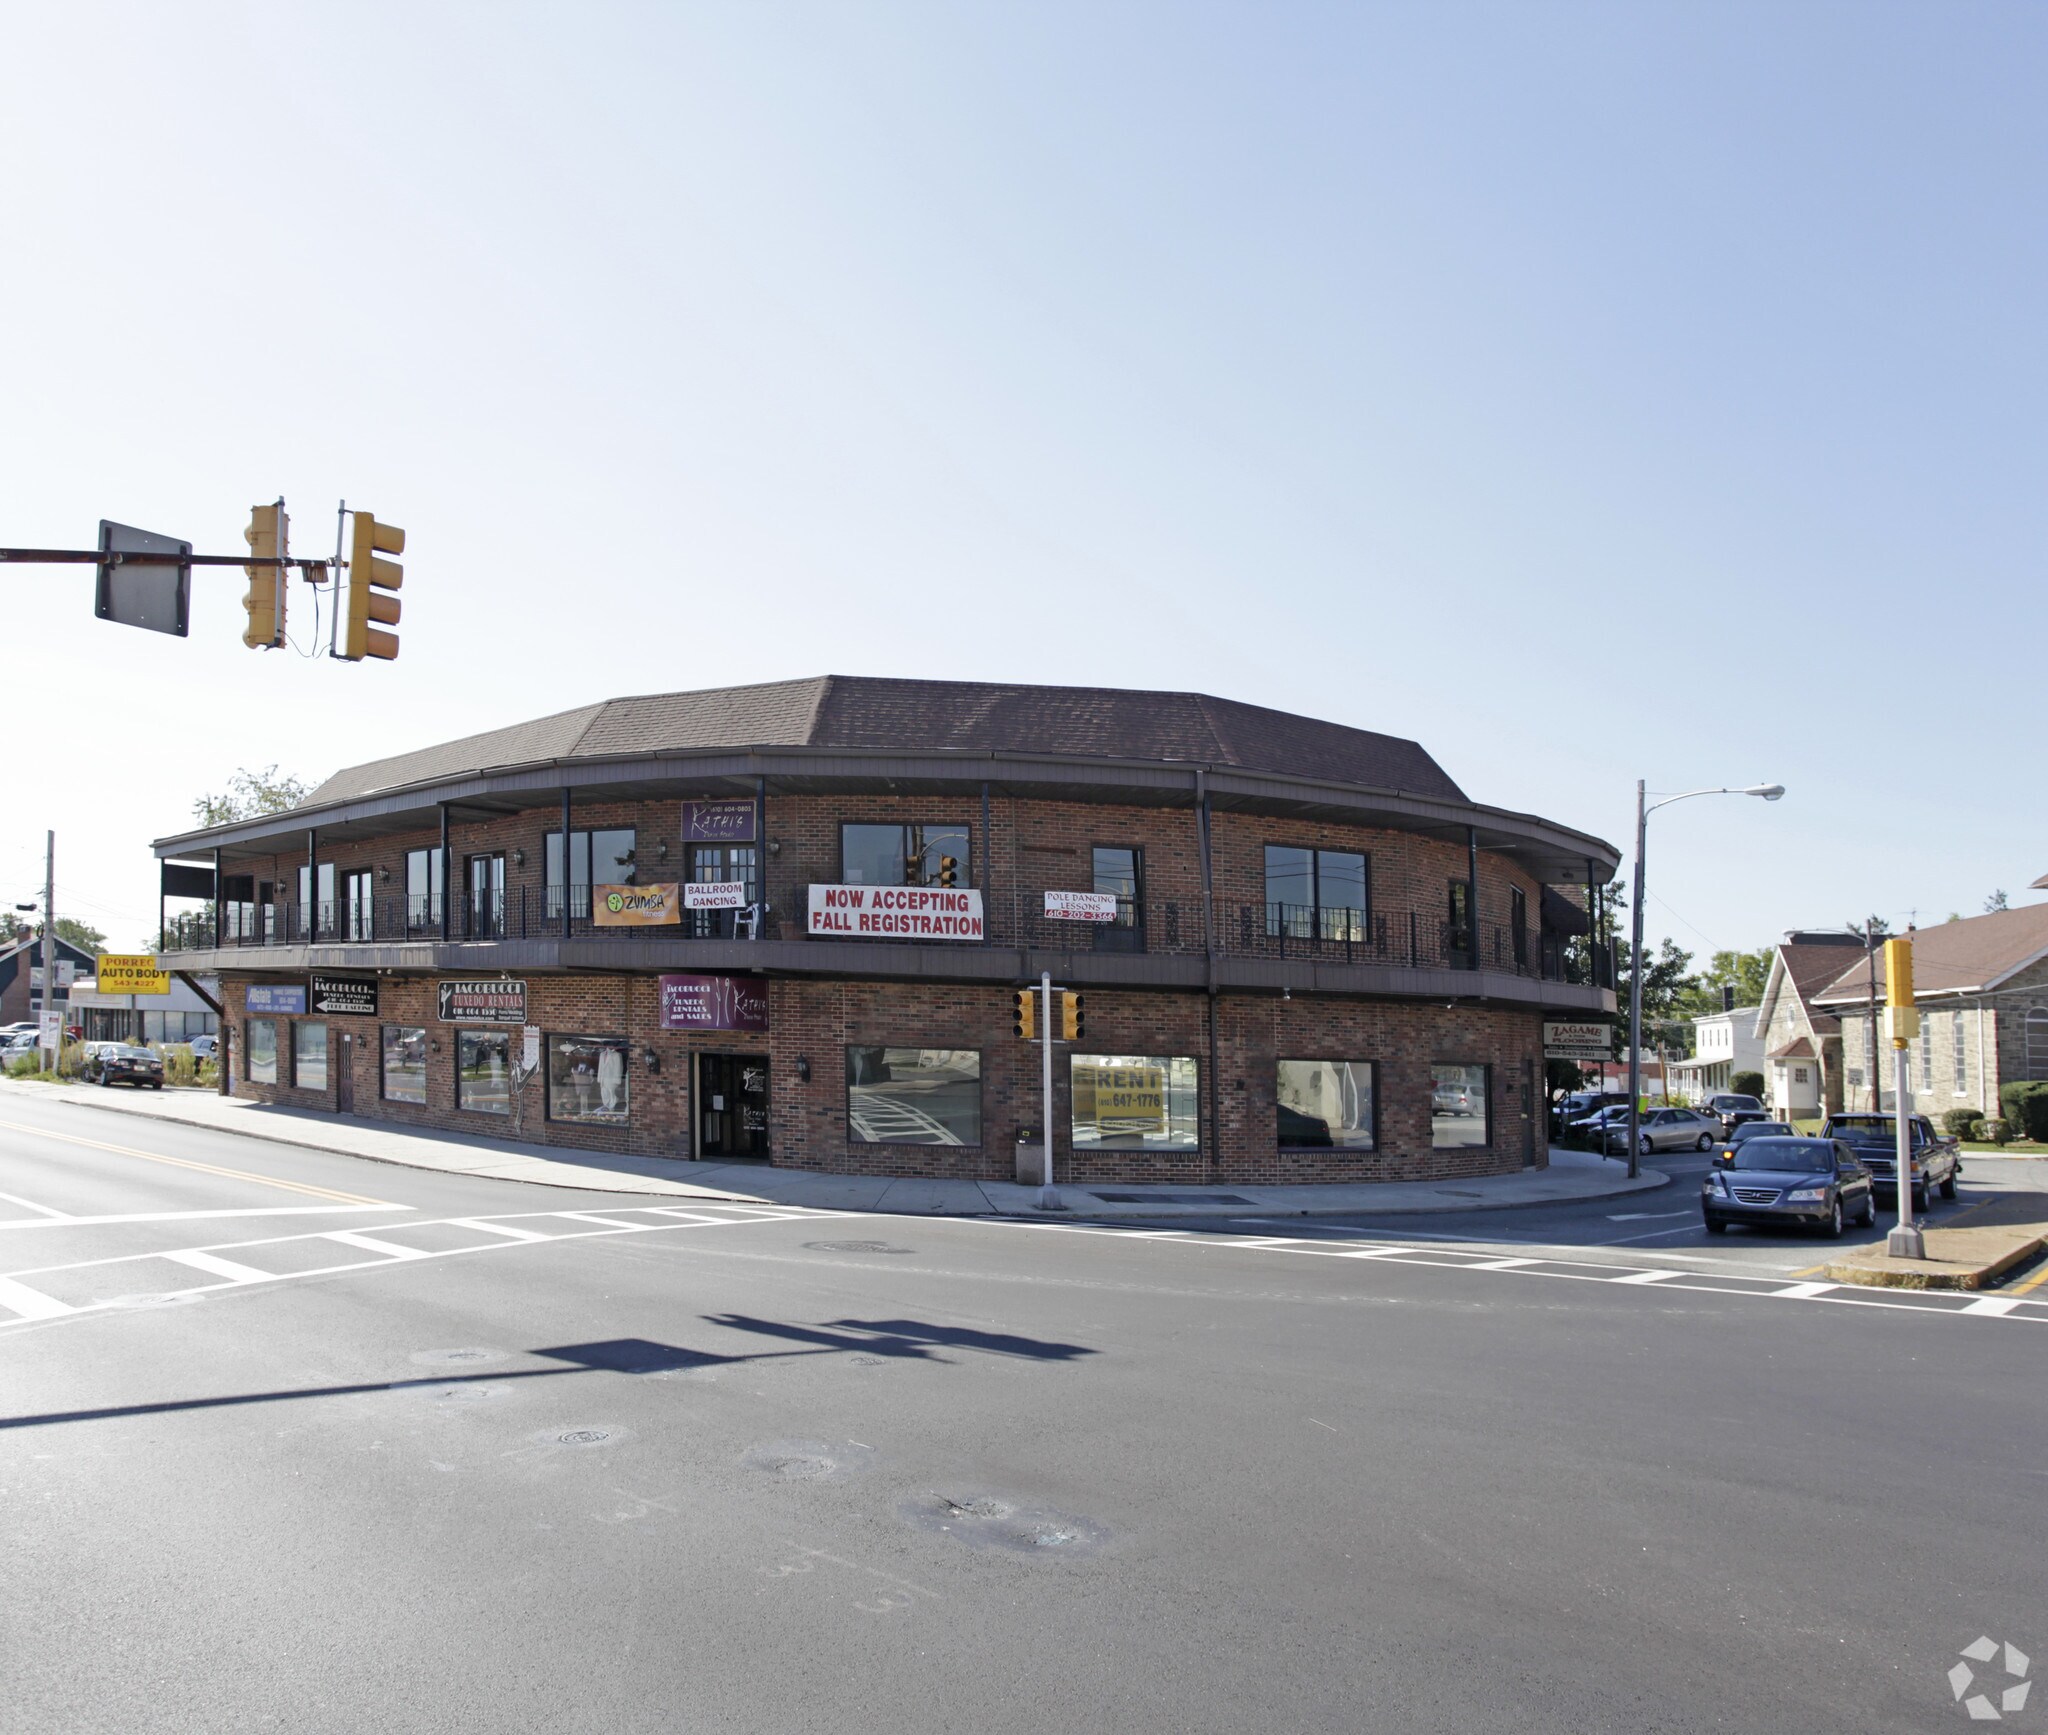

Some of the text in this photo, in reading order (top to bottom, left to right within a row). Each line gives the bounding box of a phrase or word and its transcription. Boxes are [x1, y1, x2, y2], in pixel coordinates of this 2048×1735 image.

[688, 884, 742, 894] BALLROOM
[625, 894, 665, 910] ZUMBA
[692, 897, 737, 906] DANCING
[826, 889, 969, 912] NOW ACCEPTING
[1047, 893, 1114, 903] POLE DANCING
[1061, 902, 1101, 911] LESSONS
[642, 910, 665, 918] fitness
[813, 912, 982, 936] FALL REGISTRATION
[105, 958, 156, 966] PORREC
[101, 968, 167, 978] AUTO BODY
[455, 983, 520, 994] IACOBUCCI
[453, 994, 524, 1007] TUXEDO RENTALS
[1551, 1025, 1603, 1037] ZAGAME
[1097, 1070, 1160, 1089] RENT
[1113, 1093, 1161, 1107] 647-1776
